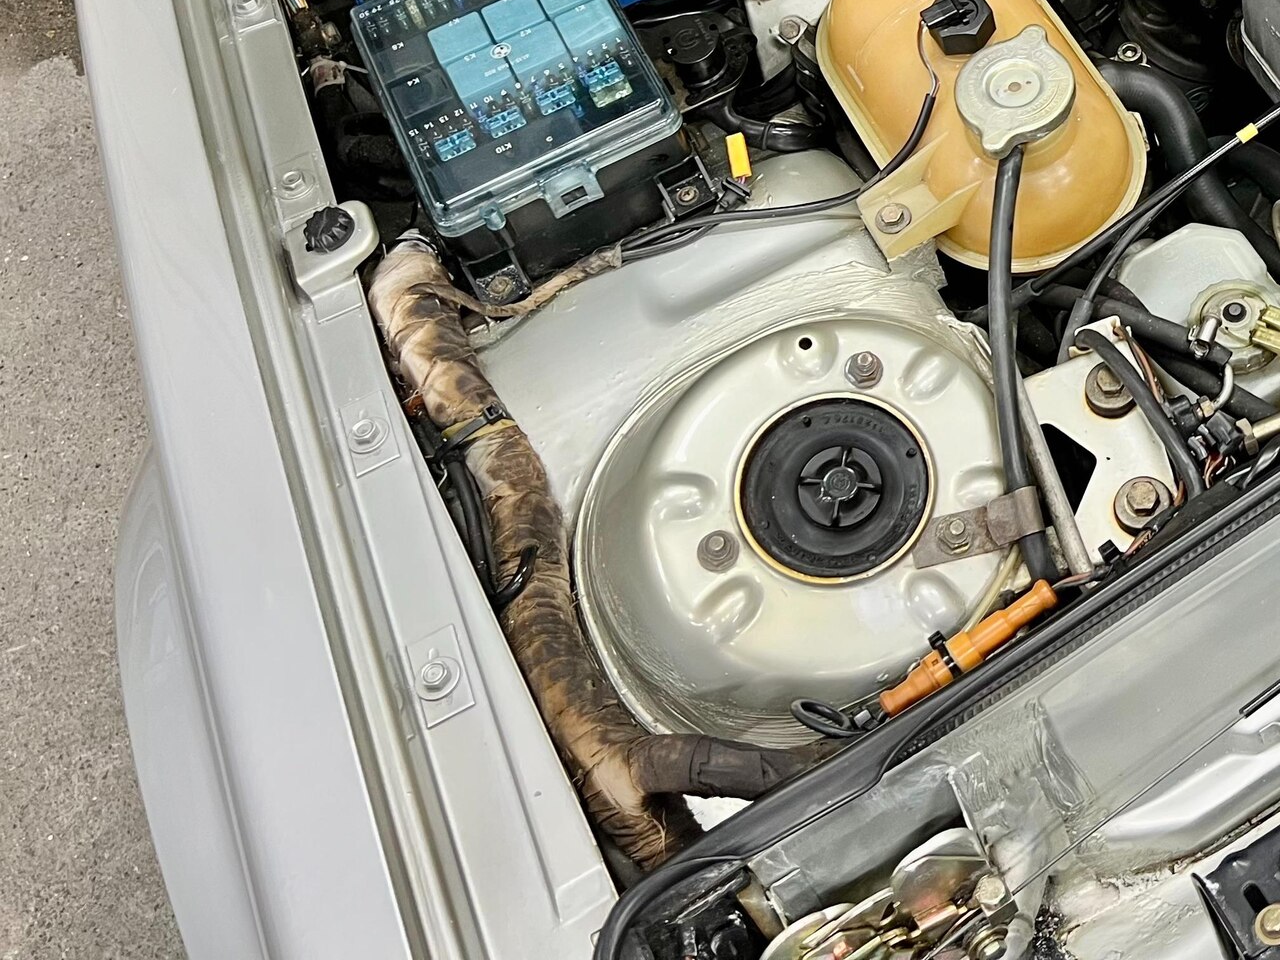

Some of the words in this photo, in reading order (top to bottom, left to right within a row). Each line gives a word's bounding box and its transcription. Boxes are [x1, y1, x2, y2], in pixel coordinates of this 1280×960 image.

[390, 40, 404, 51] K8
[405, 76, 420, 87] K4
[494, 141, 512, 154] K10
